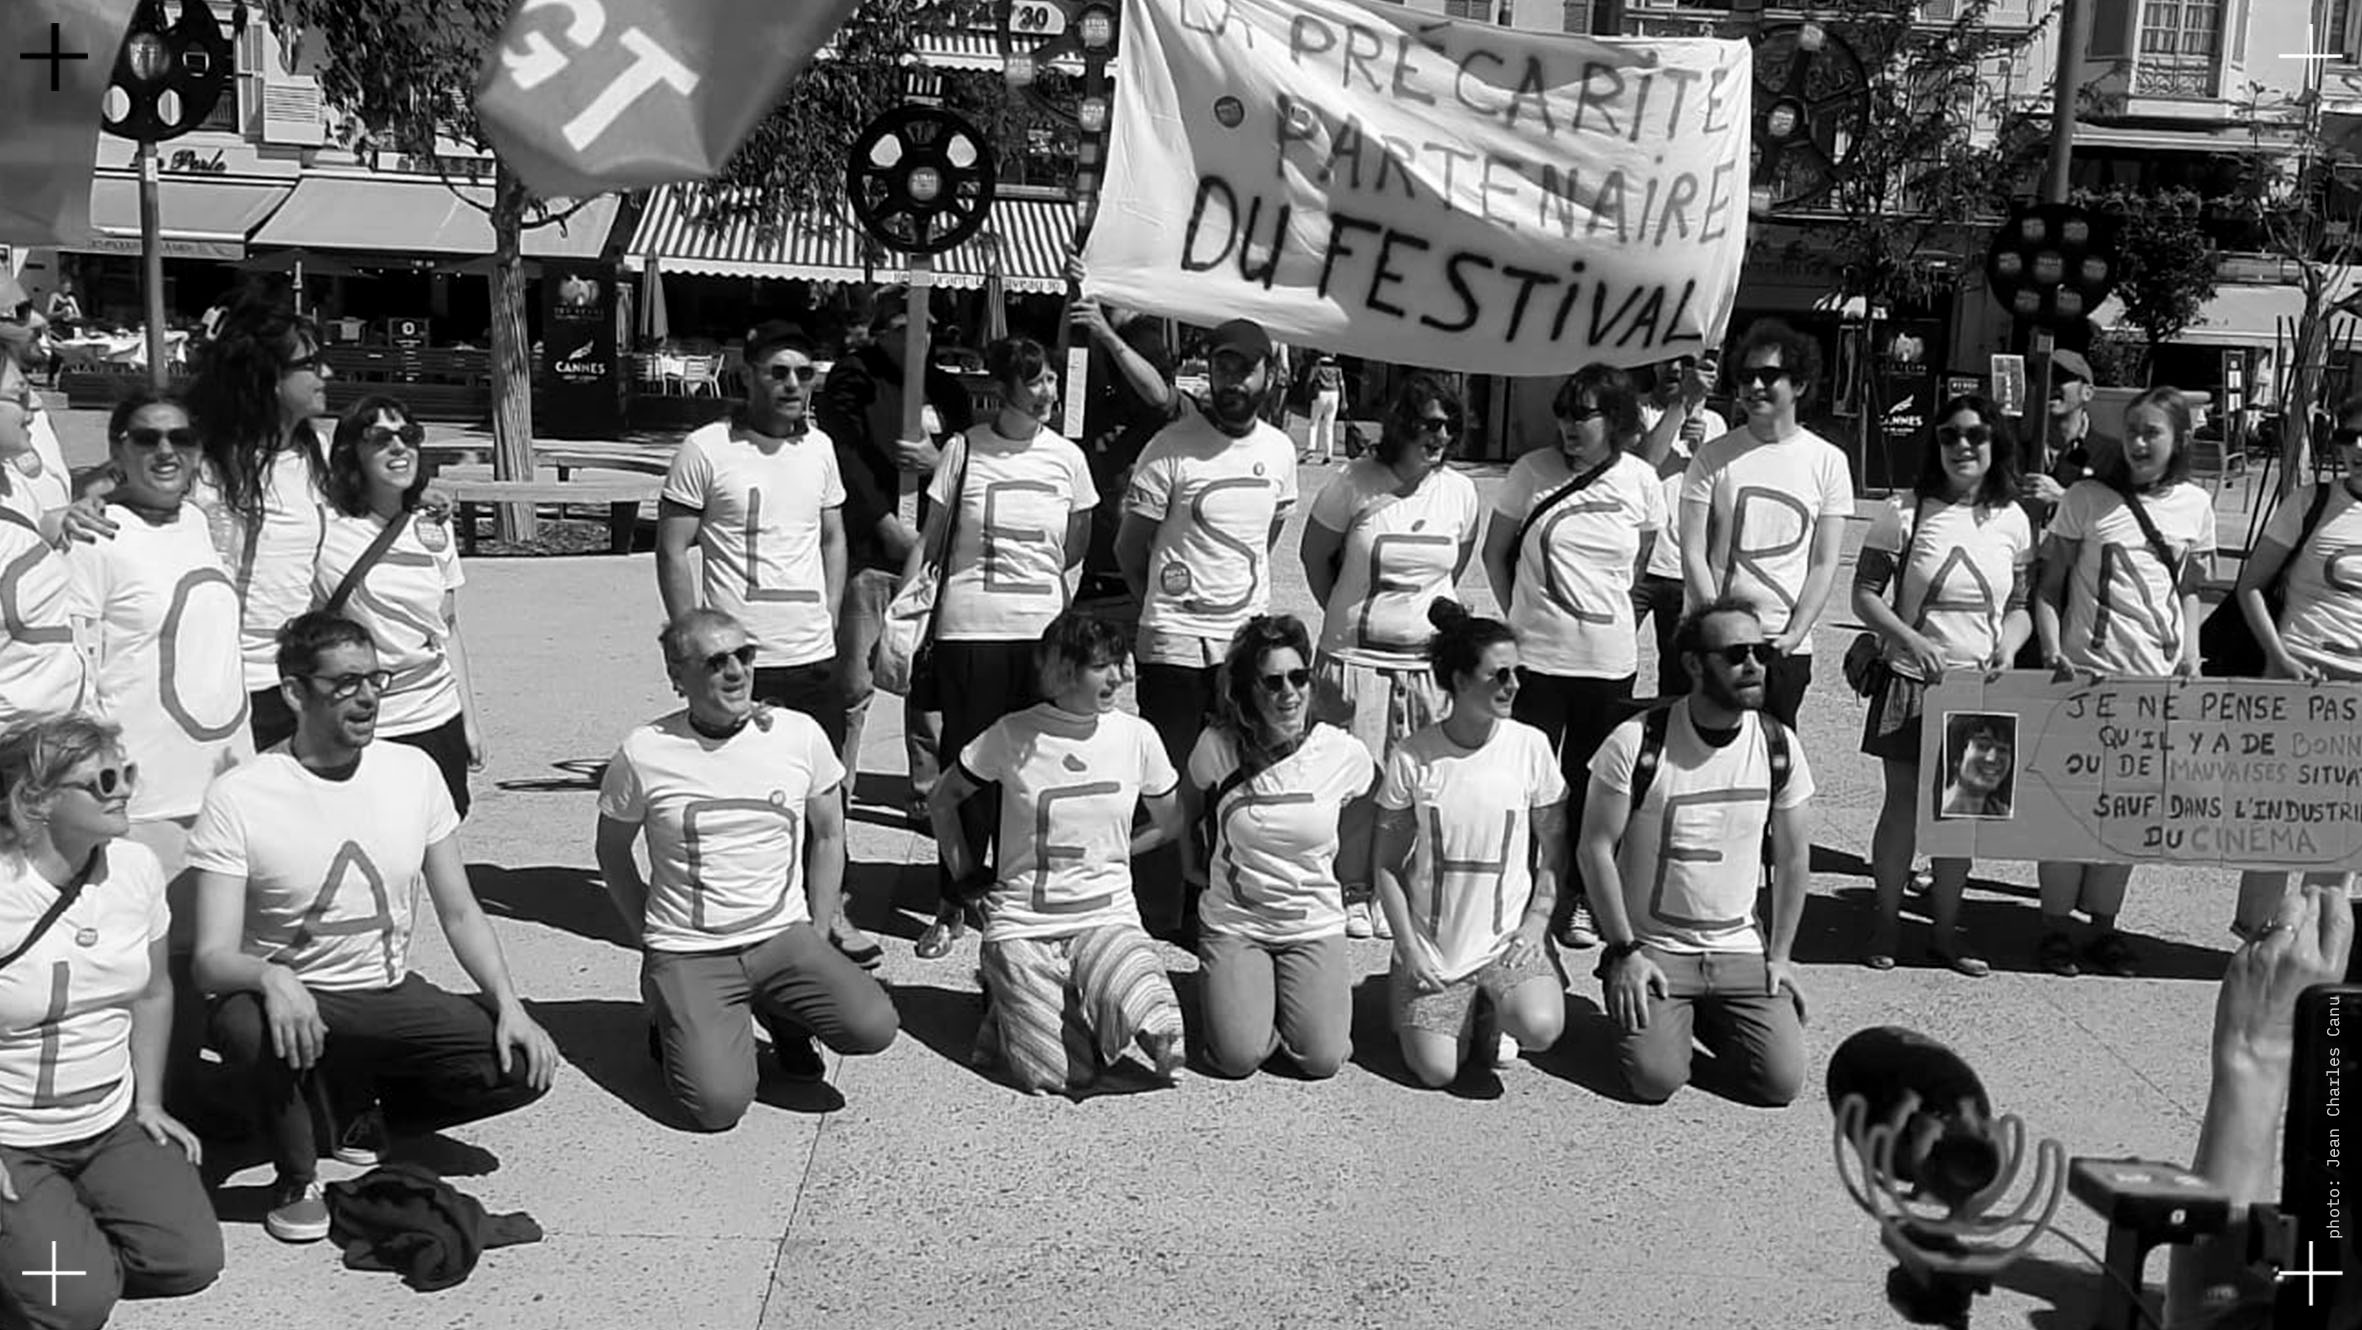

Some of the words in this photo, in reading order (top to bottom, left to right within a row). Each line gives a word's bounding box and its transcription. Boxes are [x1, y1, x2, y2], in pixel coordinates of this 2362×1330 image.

[1018, 6, 1049, 31] 30
[1181, 175, 1291, 290] DU
[554, 360, 606, 374] CANNES
[744, 486, 819, 603] L
[983, 479, 1059, 594] E
[1182, 476, 1271, 614] S
[1539, 501, 1623, 625] C
[1721, 485, 1811, 609] R
[159, 567, 249, 742] O
[1910, 545, 2000, 663] A
[2066, 692, 2117, 719] JE
[2138, 695, 2179, 720] NE
[2201, 692, 2287, 721] PENSE
[2308, 694, 2357, 721] PAS
[2099, 725, 2175, 751] QU'IL
[2189, 732, 2204, 755] Y
[2212, 732, 2231, 755] A
[2241, 732, 2275, 756] DE
[2065, 753, 2101, 775] OU
[2115, 754, 2152, 778] DE
[2169, 759, 2288, 784] MAUVAISES
[2298, 764, 2362, 787] SITUA
[2092, 793, 2157, 818] SAUF
[2168, 794, 2222, 820] DANS
[684, 799, 798, 932] D
[1221, 791, 1315, 920] C
[1430, 805, 1516, 936] H
[1653, 786, 1768, 930] E
[2143, 825, 2184, 849] DU
[287, 840, 396, 986] A
[33, 961, 126, 1108] L
